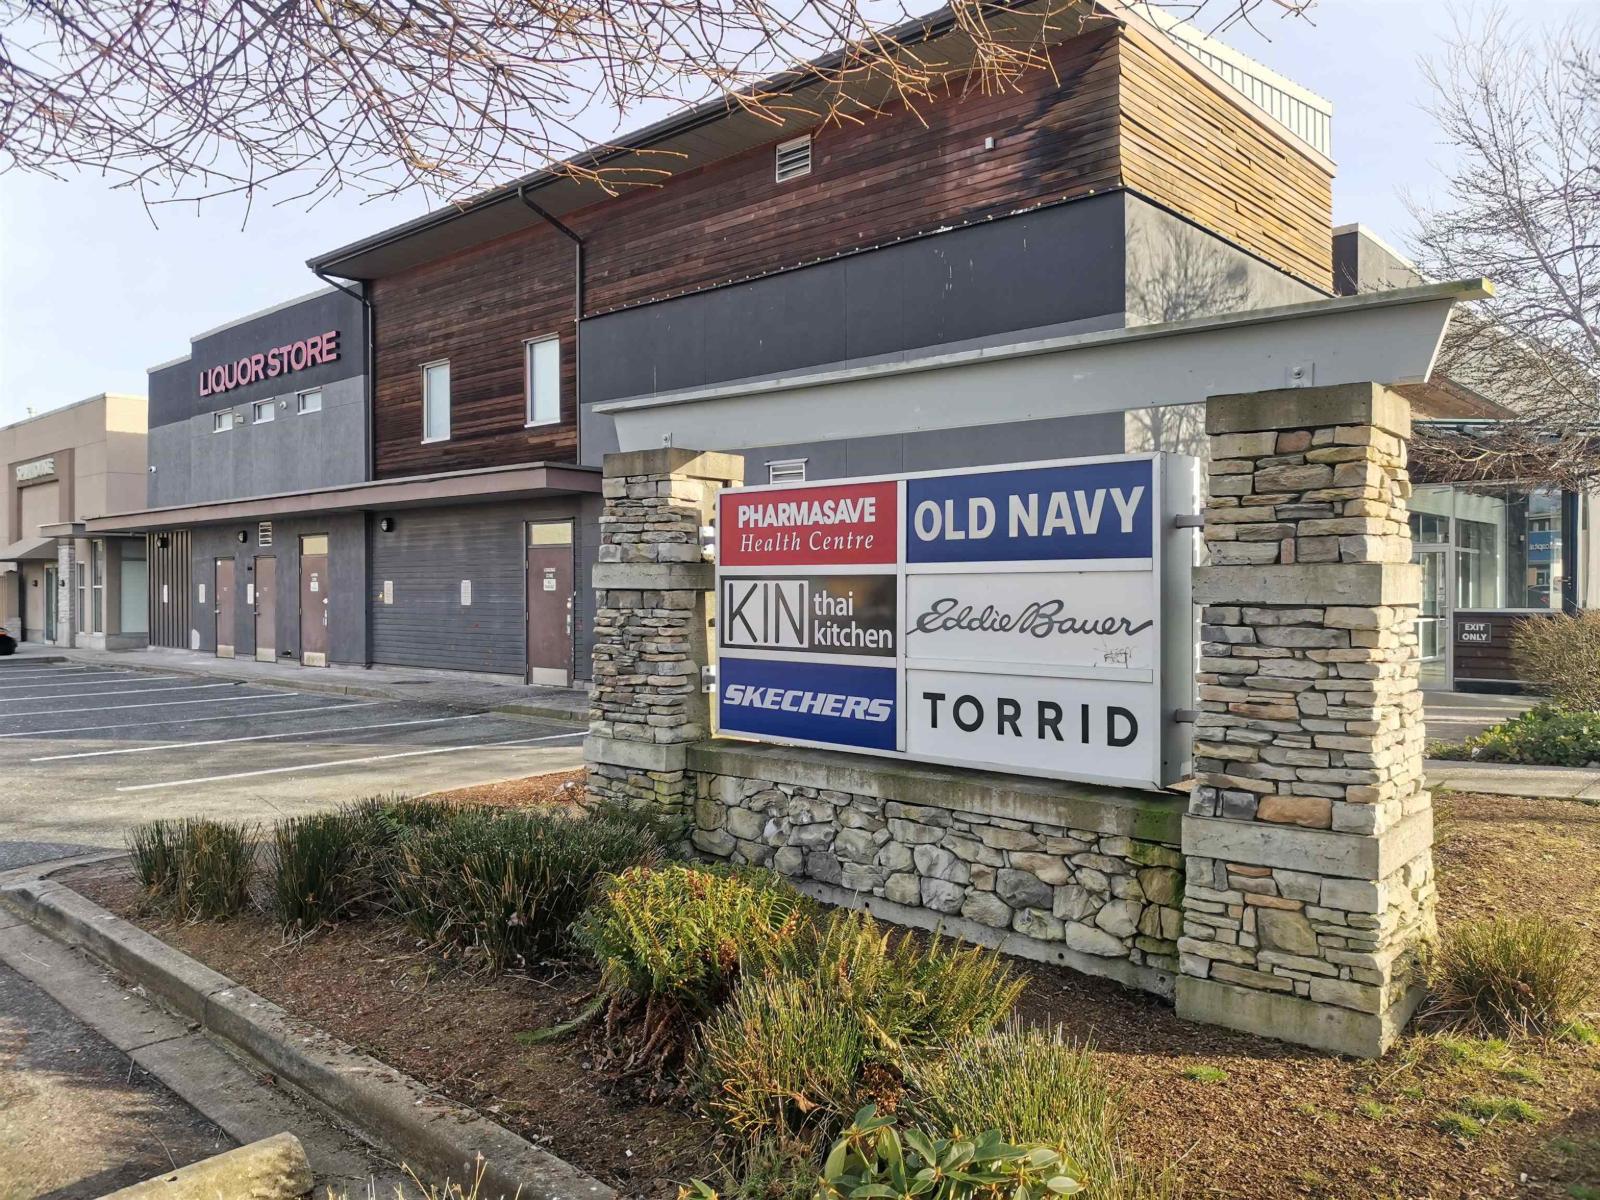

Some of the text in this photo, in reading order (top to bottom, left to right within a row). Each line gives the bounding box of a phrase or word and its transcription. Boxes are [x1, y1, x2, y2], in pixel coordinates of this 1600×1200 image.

[200, 330, 337, 396] LIQUOR STORE
[738, 497, 876, 529] PHARMASAVE
[914, 486, 1145, 542] OLD NAVY
[740, 531, 874, 552] Health Centre
[728, 582, 804, 645] KIN
[813, 590, 854, 617] thai
[906, 597, 1154, 638] Eddie Bauer
[813, 620, 893, 649] kitchen
[1462, 633, 1487, 641] ONLY
[1464, 623, 1486, 631] EXIT
[723, 683, 894, 722] SKECHERS
[922, 691, 1139, 748] TORRID
